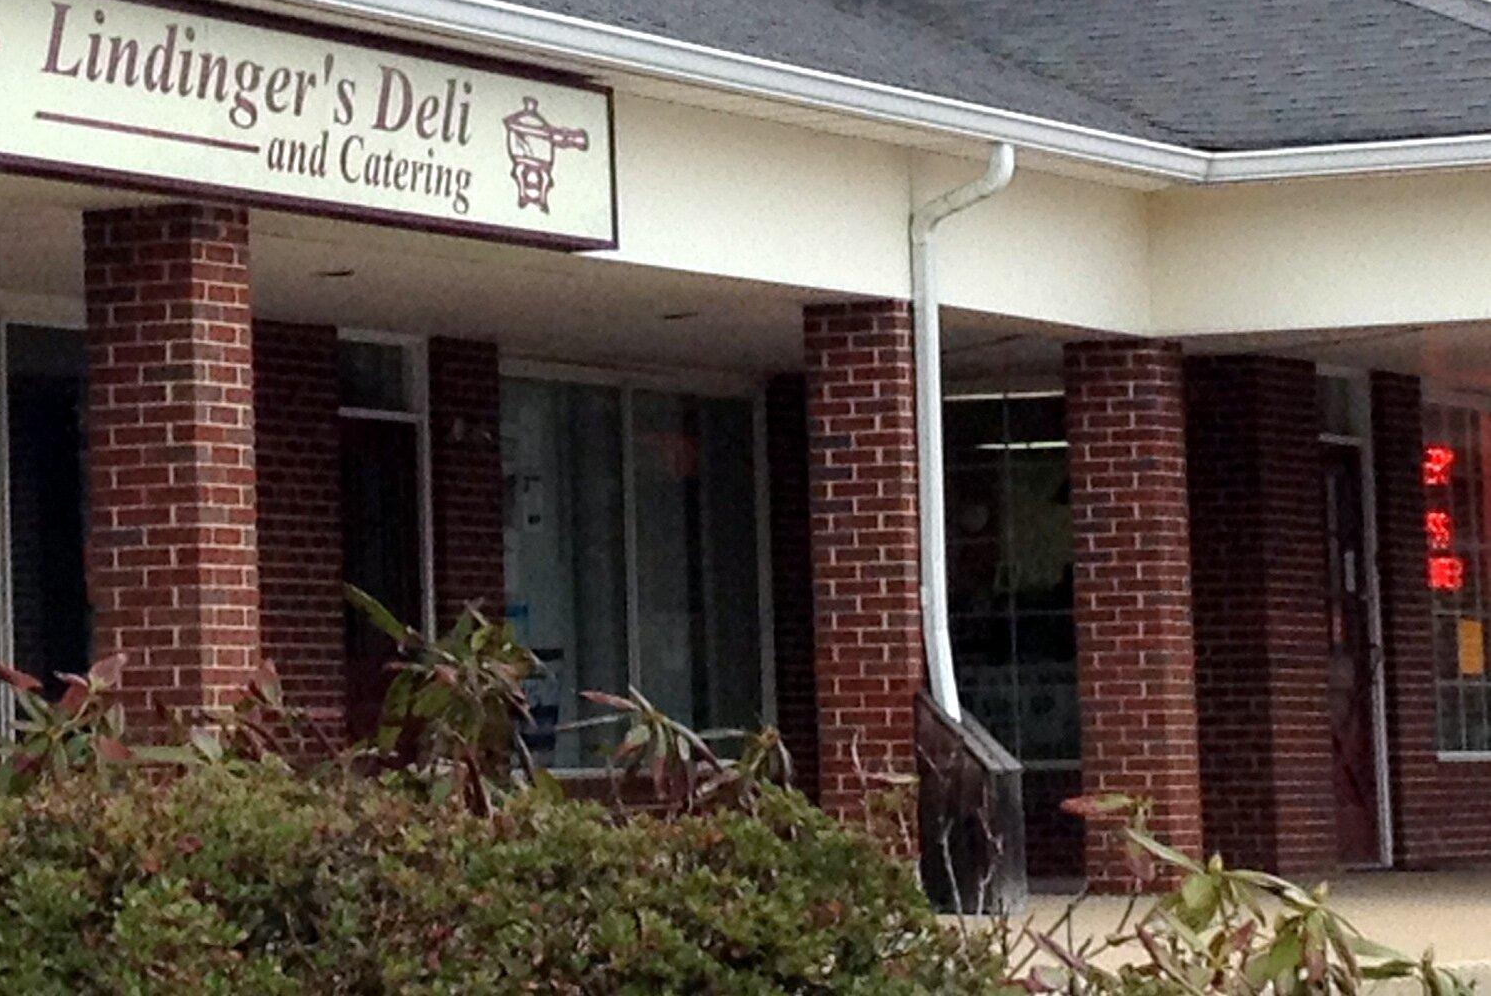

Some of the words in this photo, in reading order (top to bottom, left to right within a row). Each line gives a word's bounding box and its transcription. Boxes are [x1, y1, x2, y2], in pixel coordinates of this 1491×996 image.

[41, 0, 357, 130] Lindinger's
[371, 62, 474, 147] Deli
[267, 130, 330, 178] and
[339, 134, 472, 215] Catering
